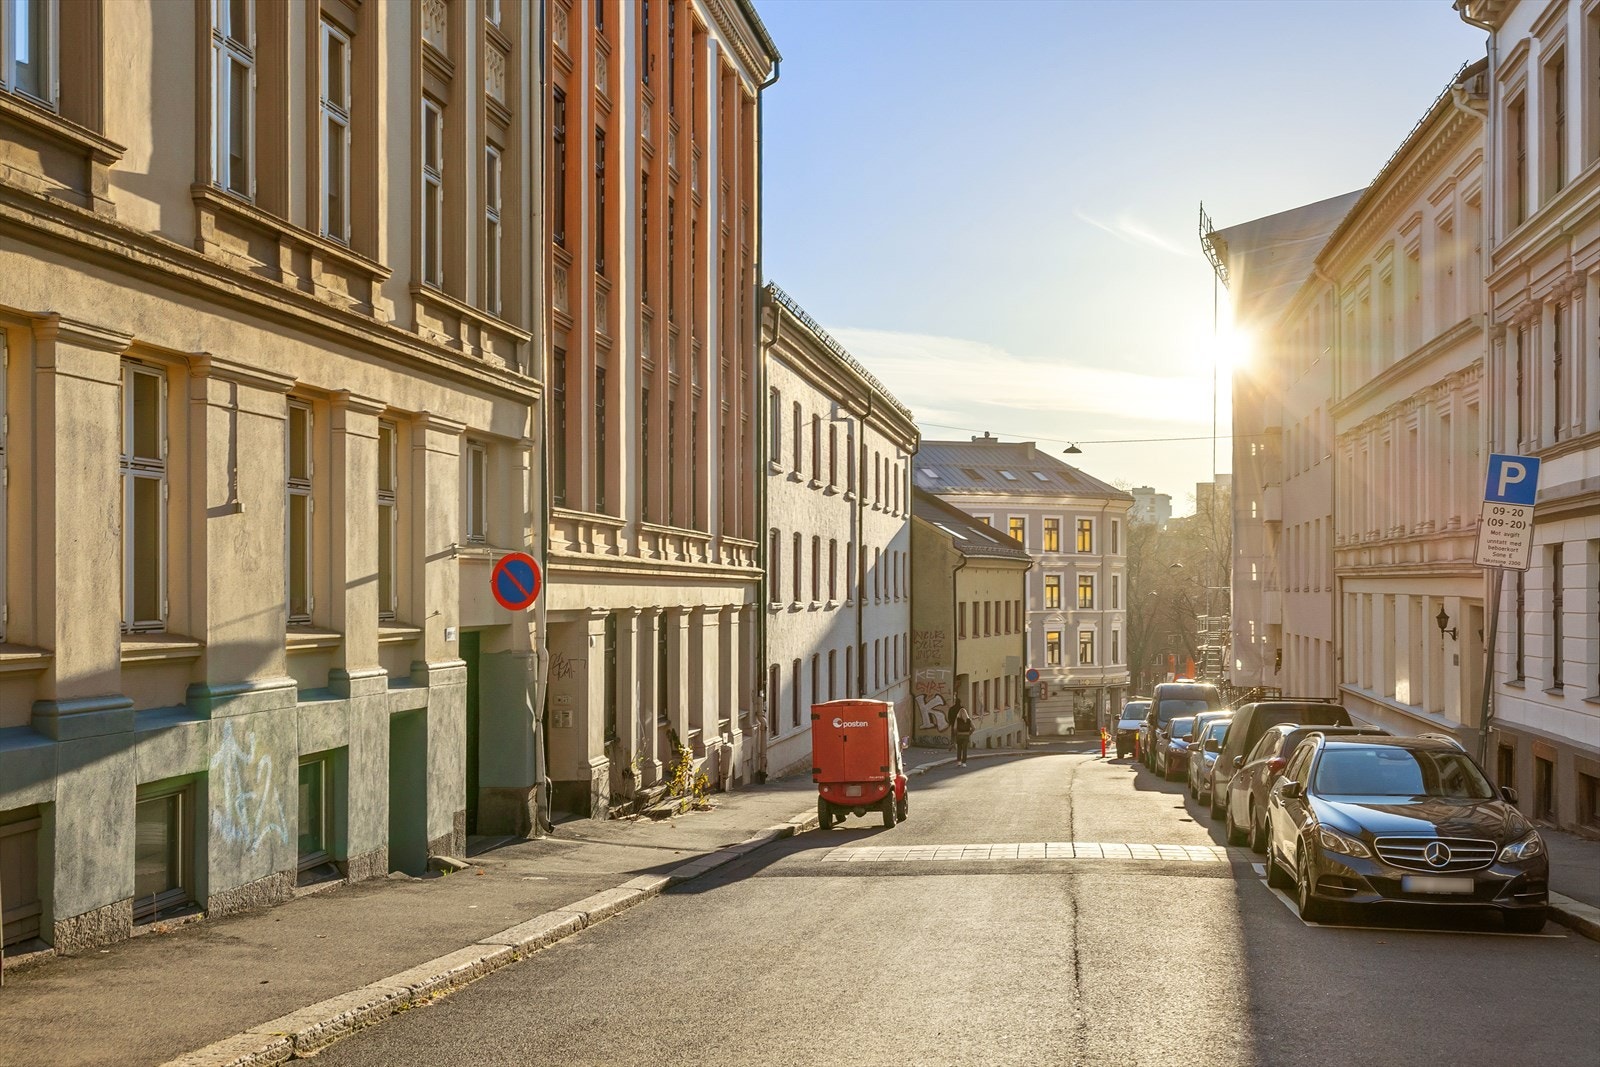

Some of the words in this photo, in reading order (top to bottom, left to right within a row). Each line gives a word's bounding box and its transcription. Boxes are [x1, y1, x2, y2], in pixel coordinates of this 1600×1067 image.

[1498, 461, 1526, 496] P
[915, 669, 951, 682] KET
[843, 721, 869, 729] posten
